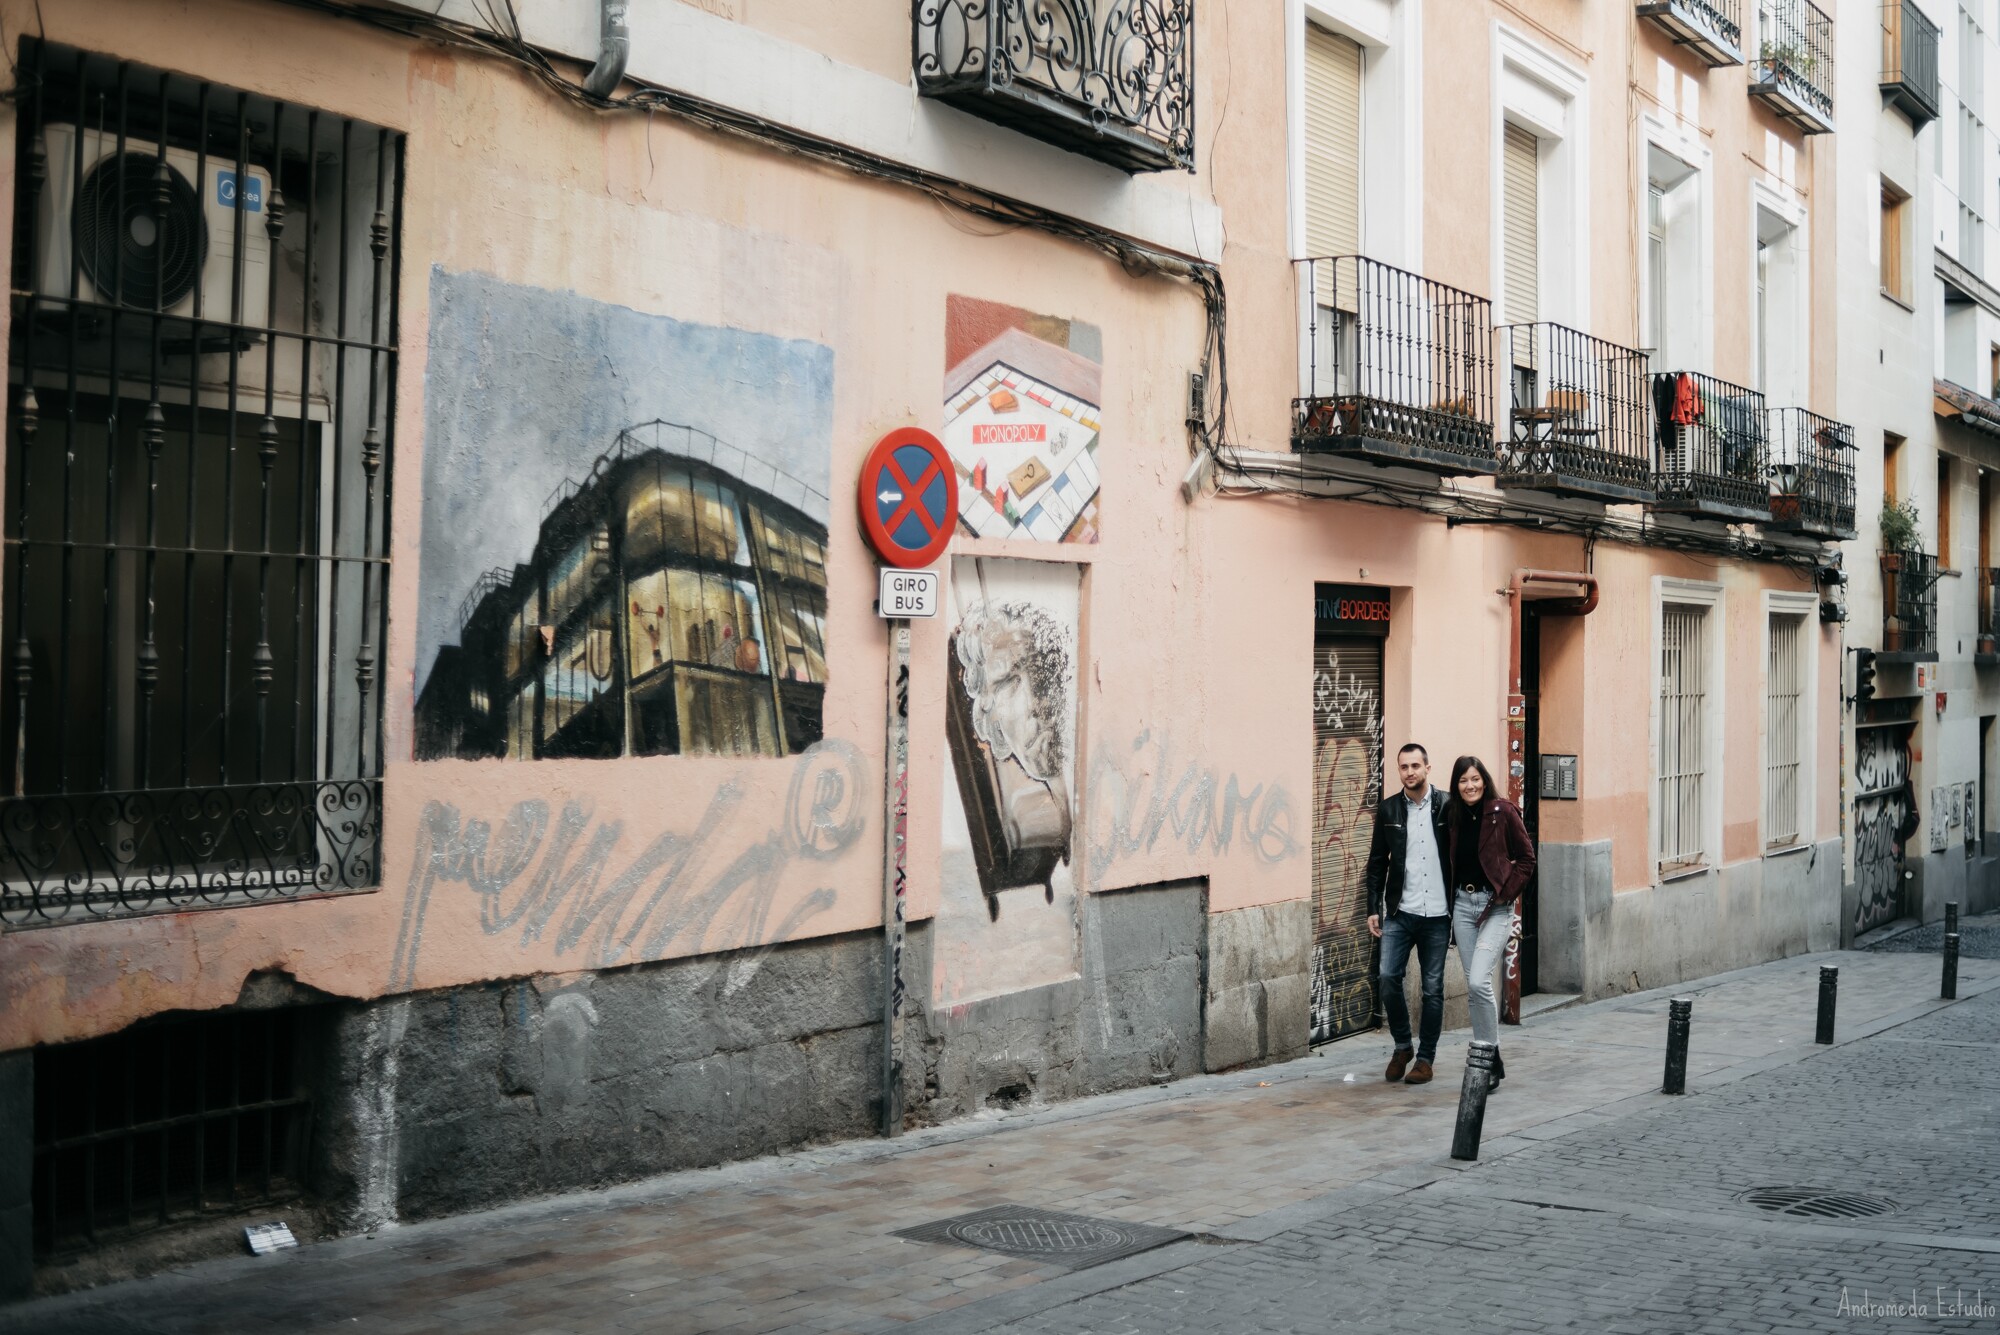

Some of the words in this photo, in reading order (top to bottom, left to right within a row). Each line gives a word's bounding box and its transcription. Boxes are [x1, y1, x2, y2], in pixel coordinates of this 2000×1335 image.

[979, 425, 1041, 442] MONOPOLY
[893, 577, 928, 592] GIRO
[895, 596, 924, 610] BUS
